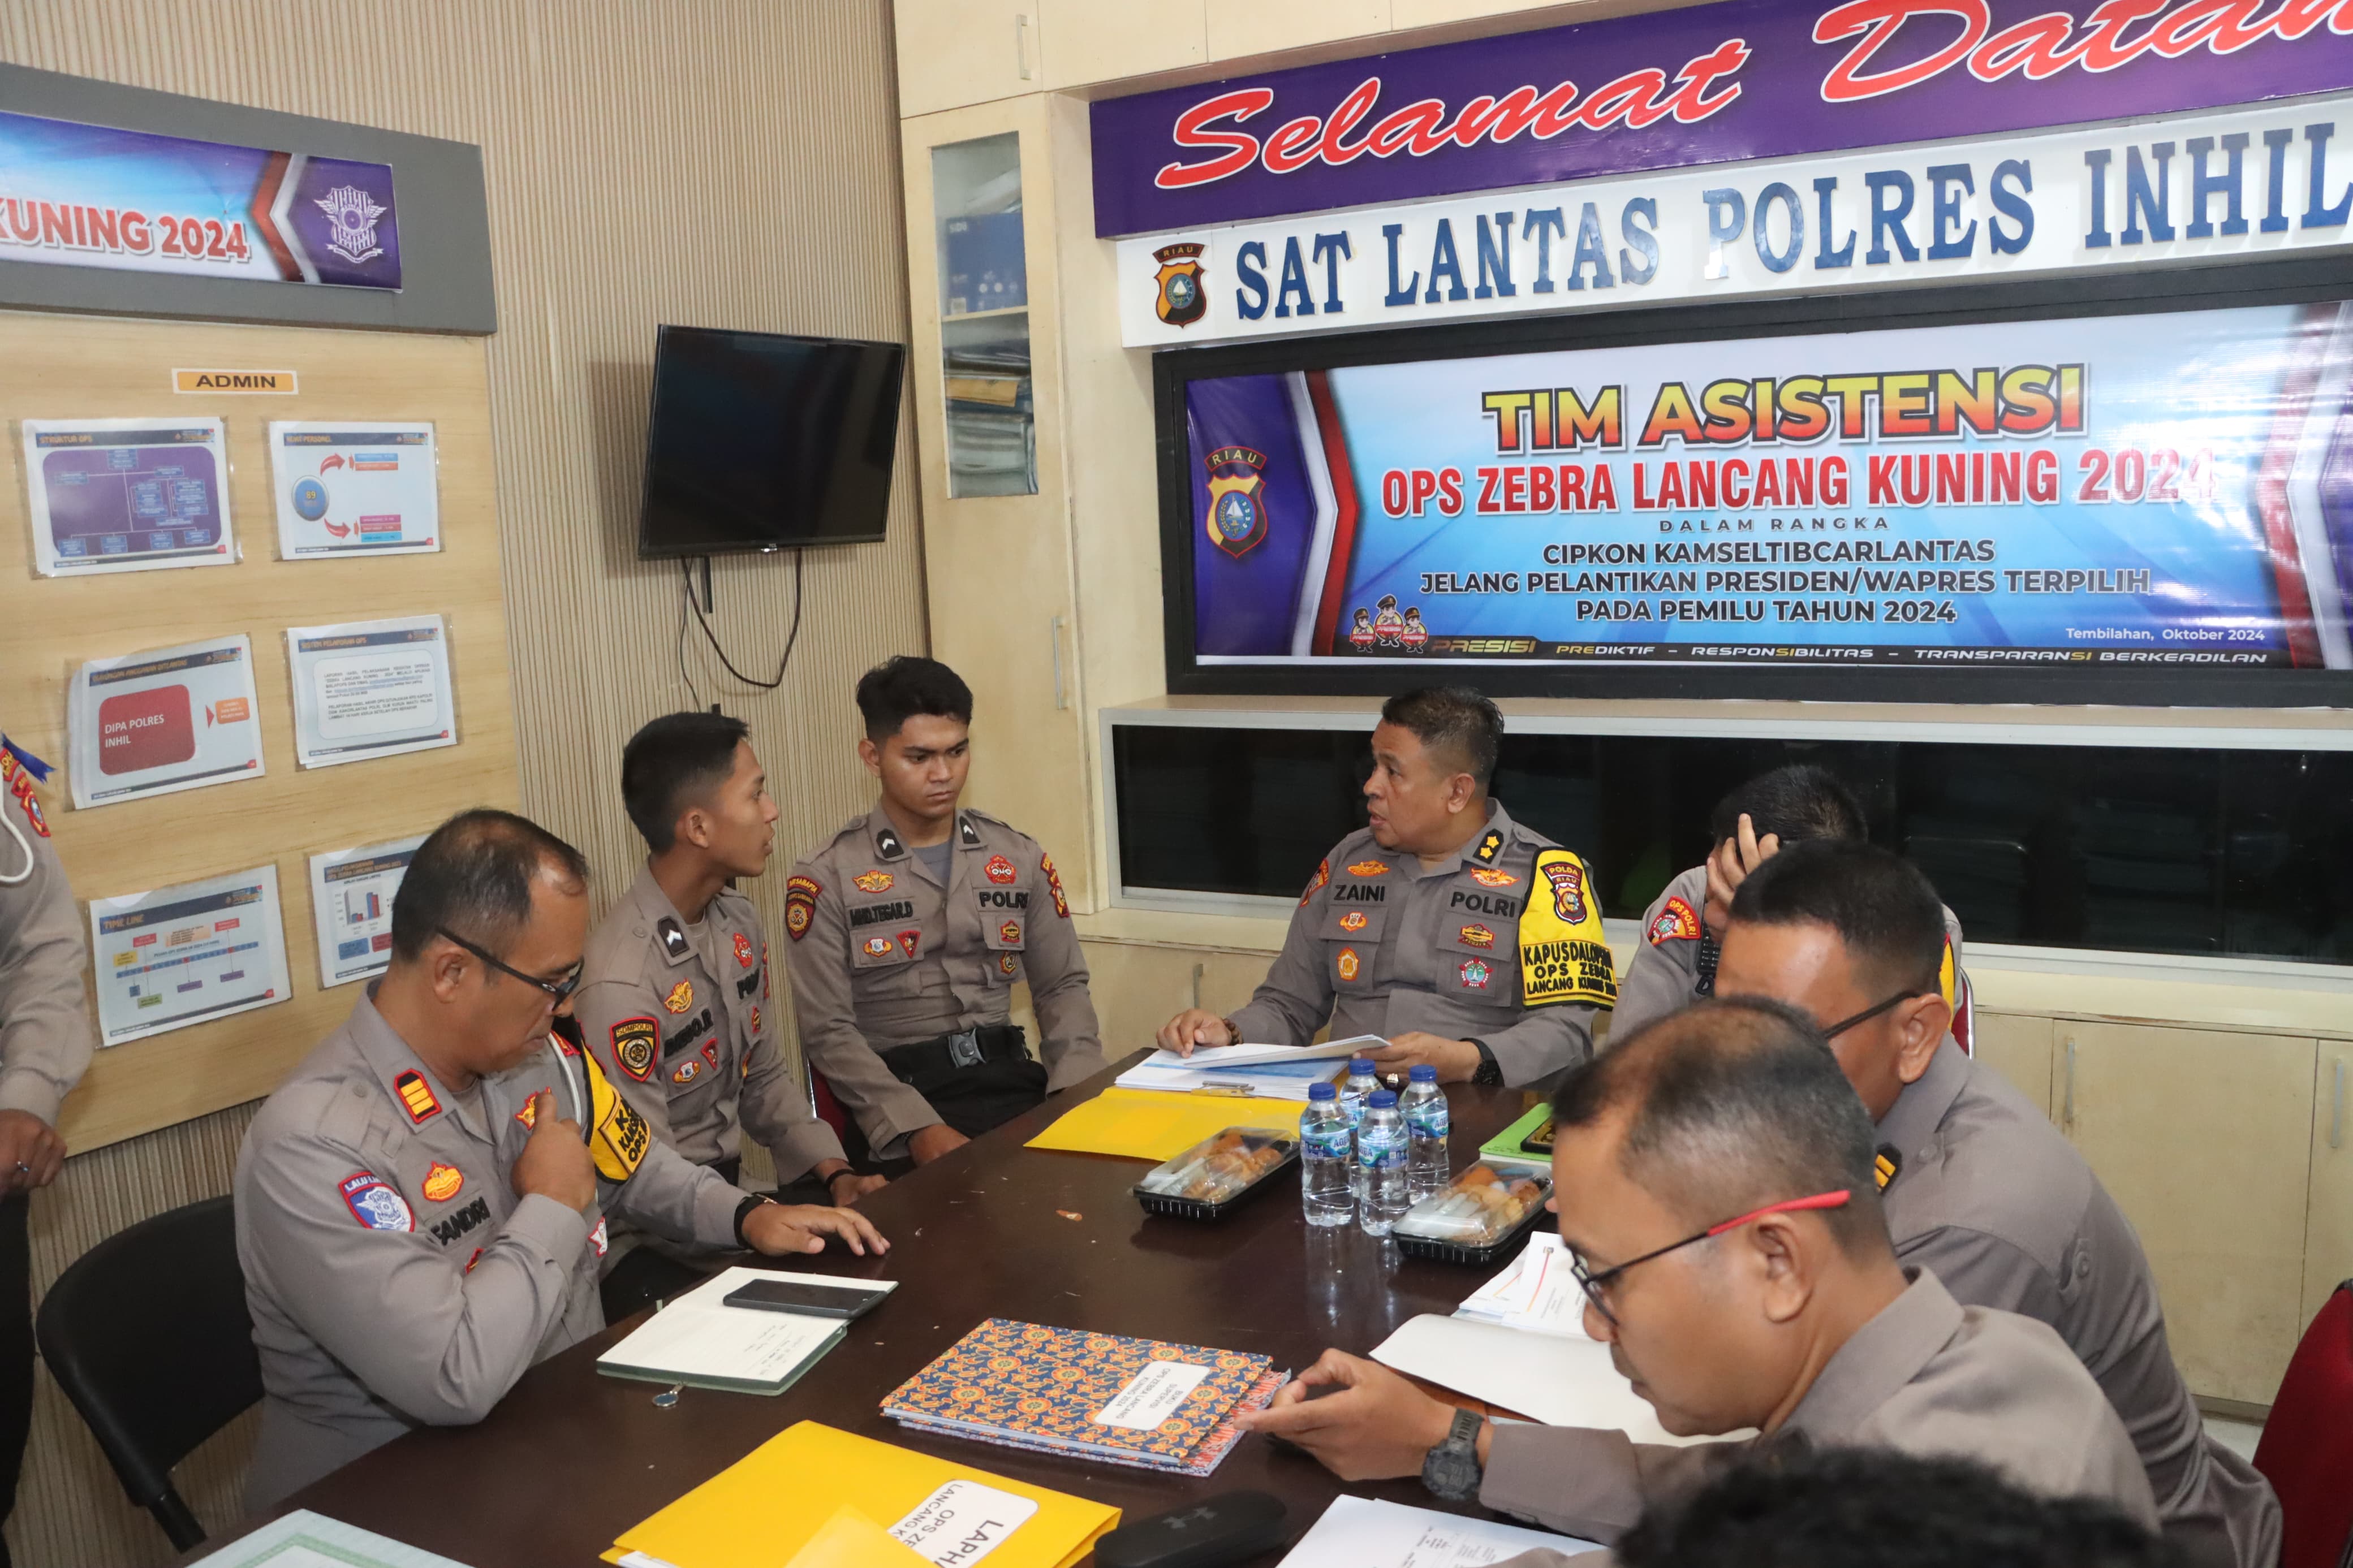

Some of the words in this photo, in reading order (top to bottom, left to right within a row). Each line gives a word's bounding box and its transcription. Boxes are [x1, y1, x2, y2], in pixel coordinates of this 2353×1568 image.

[1155, 38, 1752, 189] Selamat
[1813, 0, 2353, 102] Datan
[1236, 231, 1352, 320] SAT
[1384, 197, 1660, 307] LANTAS
[1703, 159, 2033, 280] POLRES
[2085, 123, 2353, 248] INHIL
[161, 215, 249, 259] 2024
[1163, 247, 1193, 257] RIAU
[196, 375, 276, 388] ADMIN
[1482, 386, 1622, 453] TIM
[1639, 363, 2087, 447] ASISTENSI
[1212, 450, 1257, 465] RIAU
[1381, 469, 1464, 517] OPS
[1477, 463, 1619, 513] ZEBRA
[1634, 455, 1848, 510] LANCANG
[1869, 450, 2061, 507] KUNING
[2077, 447, 2216, 504] 2024
[1660, 519, 1754, 533] DALAM
[1771, 517, 1889, 530] RANGKA
[1543, 543, 1646, 565] CIPKON
[1655, 539, 1996, 564] KAMSELTIBCARLANTAS
[1421, 573, 1520, 594] JELANG
[1527, 571, 1696, 593] PELANTIKAN
[1705, 569, 1996, 597] PRESIDEN/WAPRES
[2003, 569, 2149, 593] TERPILIH
[1577, 601, 1650, 621] PADA
[1658, 599, 1762, 621] PEMILU
[1773, 599, 1874, 622] TAHUN
[1883, 599, 1956, 624] 2024
[2066, 628, 2154, 641] Tembilahan,
[2162, 628, 2223, 641] Oktober
[2228, 629, 2265, 641] 2024
[1433, 640, 1536, 653] PRESISI
[1556, 645, 1656, 655] PREDIKTIF
[1691, 647, 1873, 658] RESPONSIBILITAS
[1915, 649, 2092, 660] TRANSPARANSI
[2100, 652, 2267, 663] BERKEADILAN
[105, 721, 127, 734] DIPA
[129, 714, 165, 729] POLRES
[105, 735, 131, 748] INHIL
[1549, 866, 1579, 876] POLDA
[979, 891, 1029, 909] POLRI
[1334, 884, 1385, 902] ZAINI
[1451, 891, 1515, 918] POLRI
[1669, 900, 1684, 912] OPS
[1681, 909, 1697, 936] POLRI
[1534, 962, 1568, 979] OPS
[1580, 962, 1612, 982] ZEBRA
[1527, 977, 1574, 995] LANCANG
[344, 1177, 369, 1190] LALU
[1149, 1383, 1178, 1409] SUPERVISI
[1165, 1390, 1184, 1405] BUKU
[904, 1483, 963, 1528] LANCANG
[921, 1509, 955, 1534] OPS
